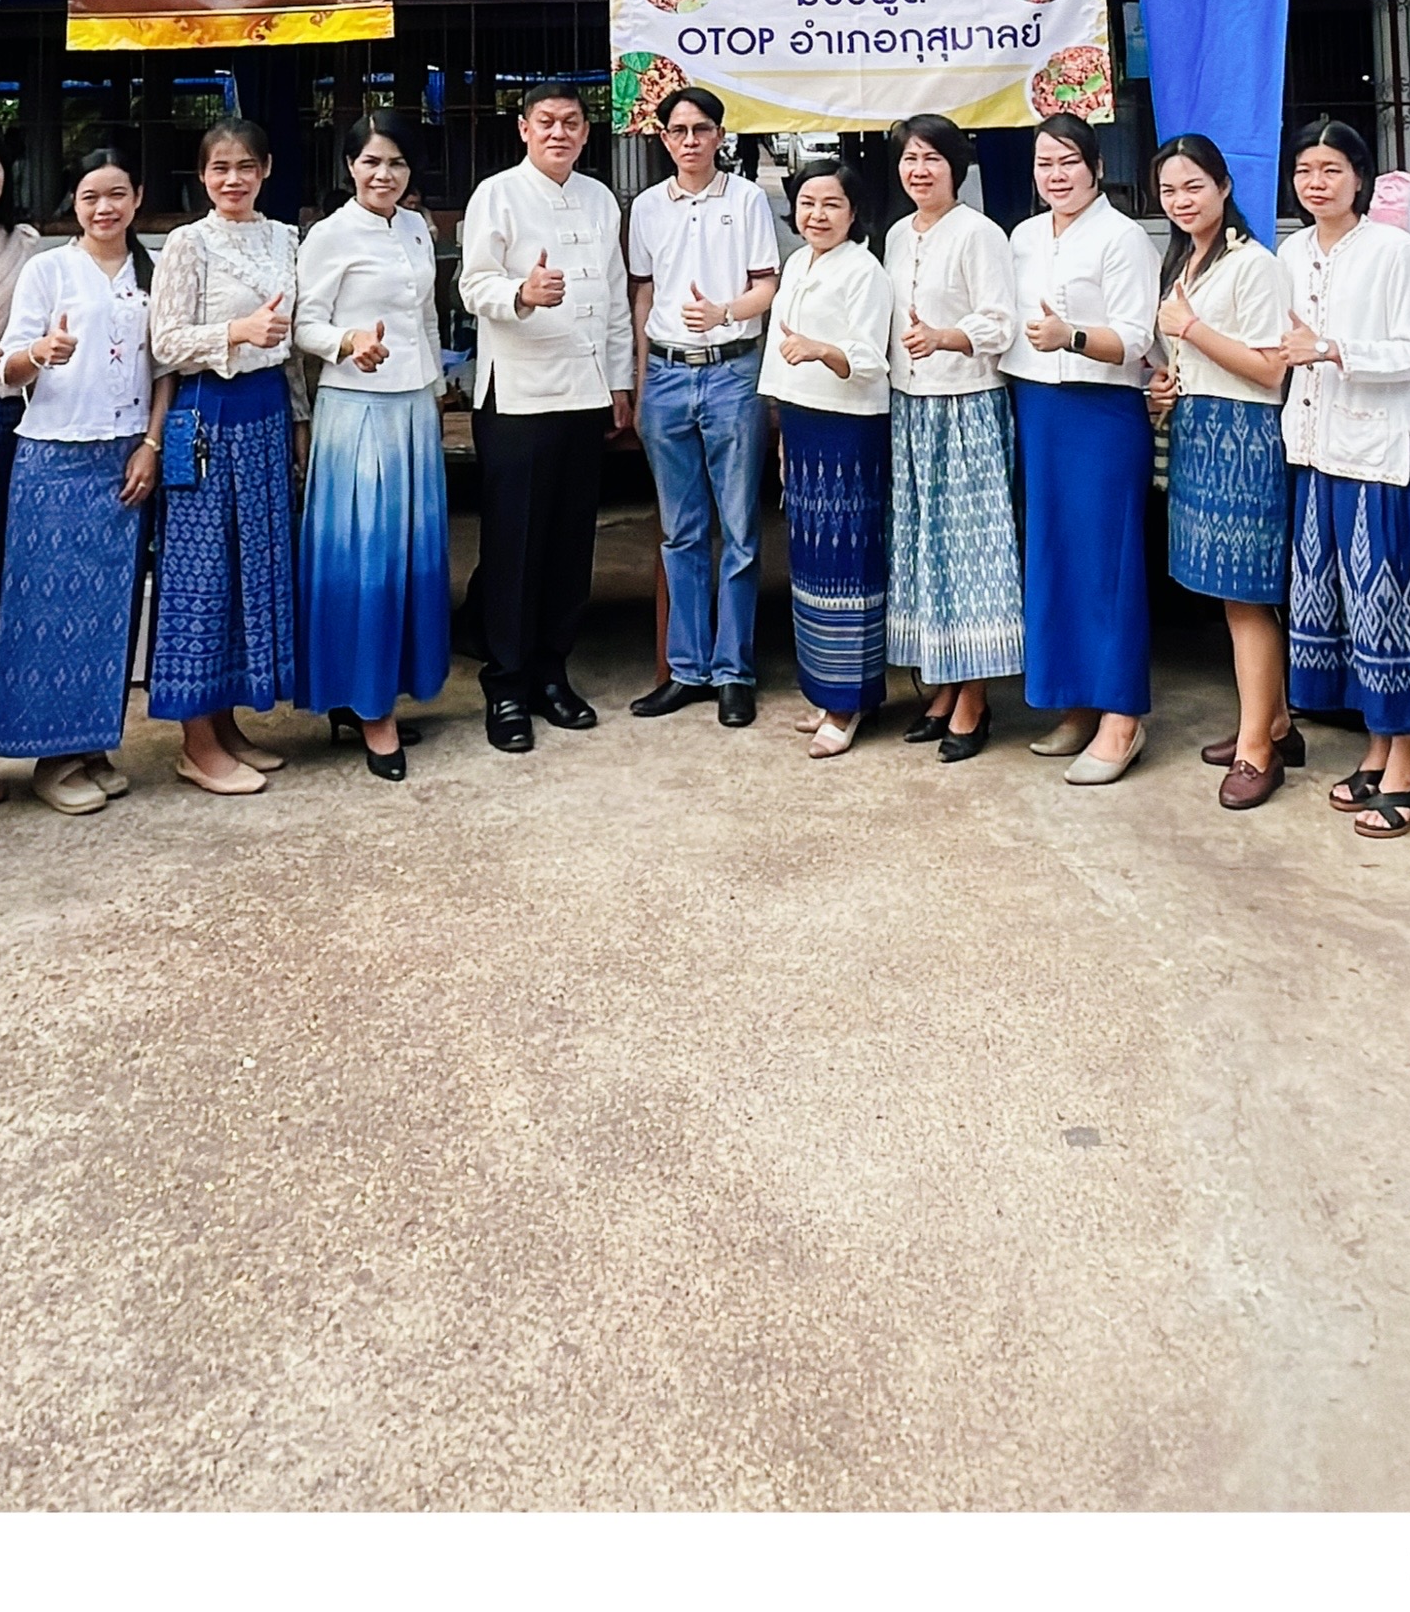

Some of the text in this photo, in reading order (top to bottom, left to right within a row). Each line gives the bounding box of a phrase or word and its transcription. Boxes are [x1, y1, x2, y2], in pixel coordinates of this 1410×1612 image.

[677, 12, 1043, 62] OTOP อำเภอกุสุมาลย์
